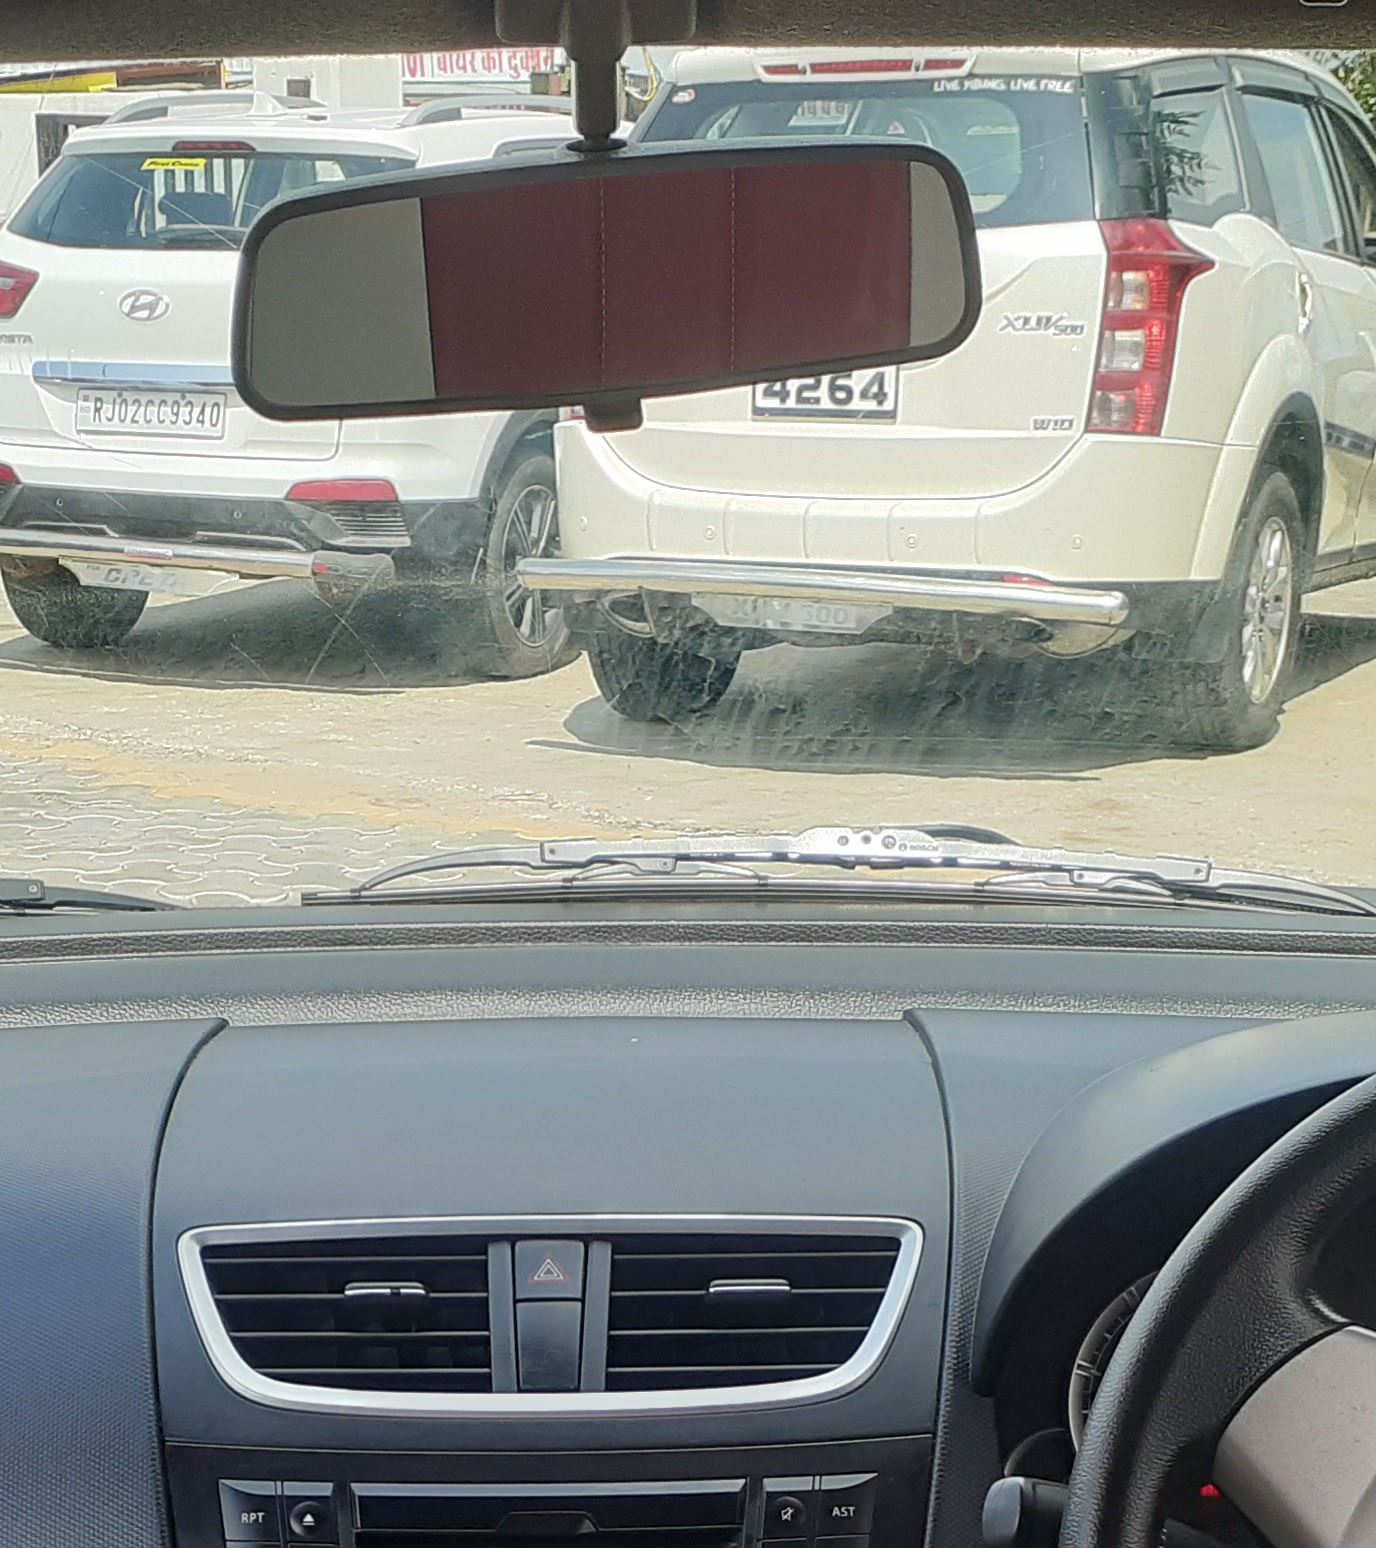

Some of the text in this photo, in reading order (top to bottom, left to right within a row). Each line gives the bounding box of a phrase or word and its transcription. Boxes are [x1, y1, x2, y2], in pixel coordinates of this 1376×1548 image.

[933, 78, 1075, 94] LIVE YOUNG LIVE FREE
[762, 371, 889, 407] 4264
[92, 395, 221, 428] RJ02CC9340
[241, 1512, 265, 1524] RPT
[832, 1506, 856, 1517] AST
